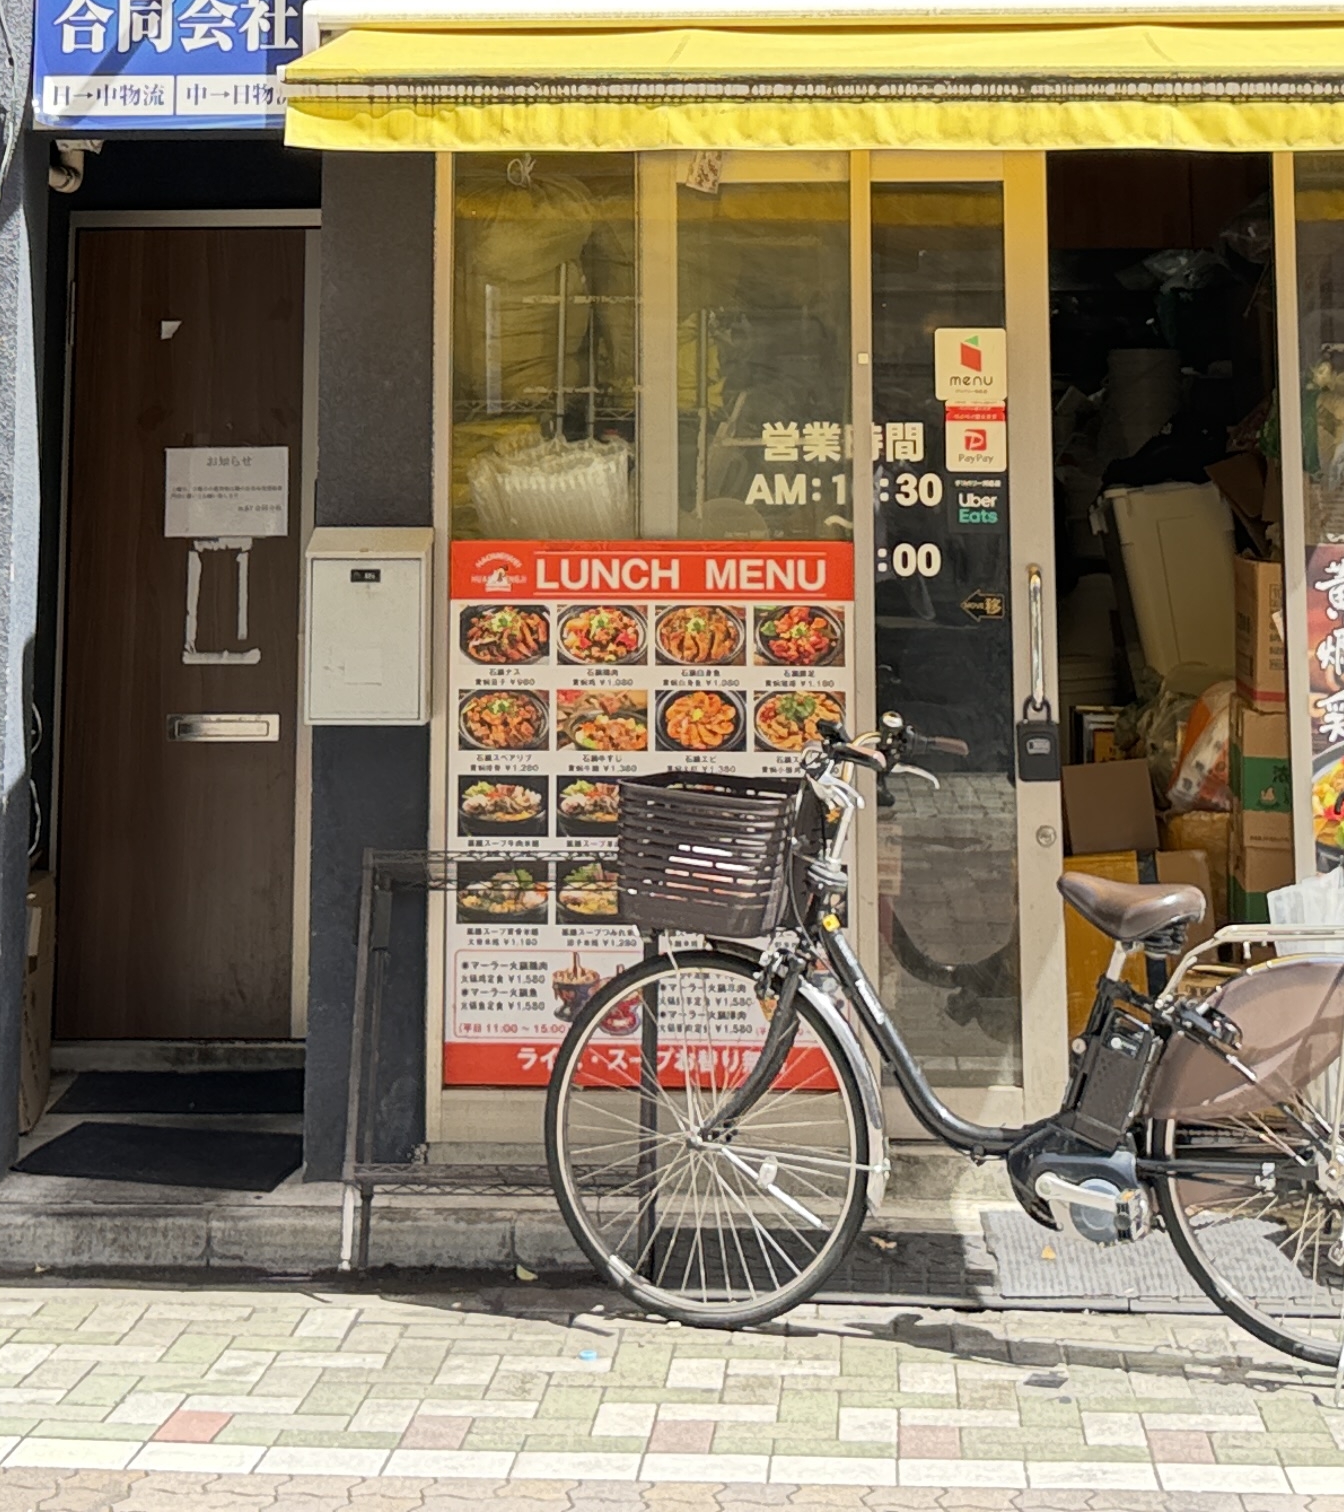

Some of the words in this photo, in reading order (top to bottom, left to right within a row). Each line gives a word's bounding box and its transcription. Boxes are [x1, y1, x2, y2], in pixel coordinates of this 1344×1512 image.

[949, 375, 994, 386] menu
[206, 455, 253, 467] お知らせ
[958, 453, 995, 464] PayPay
[745, 473, 943, 506] AM:1:30
[958, 493, 998, 508] Uber
[958, 509, 998, 524] Eats
[535, 557, 680, 591] LUNCH
[705, 557, 828, 591] MENU
